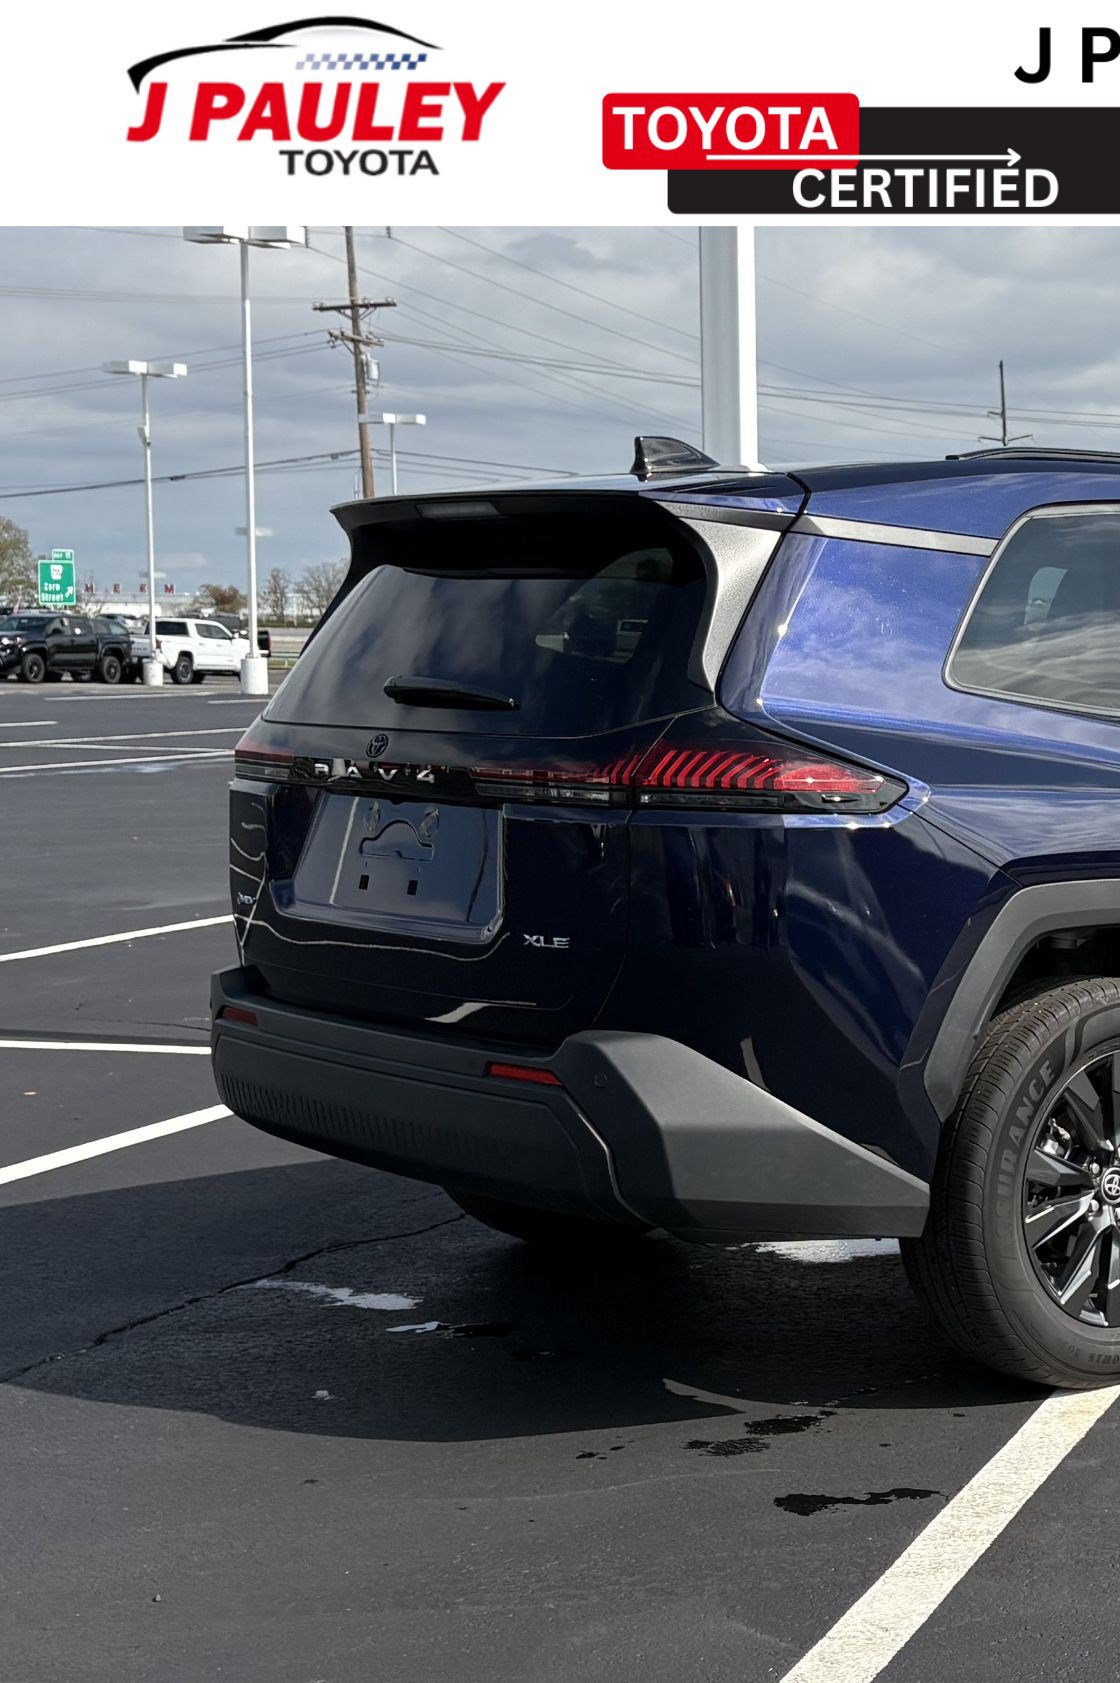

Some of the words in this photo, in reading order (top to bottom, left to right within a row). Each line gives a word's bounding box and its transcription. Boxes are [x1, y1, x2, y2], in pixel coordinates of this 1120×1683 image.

[314, 762, 436, 784] RAV4
[523, 933, 570, 949] XLE
[995, 1059, 1056, 1222] URANCE
